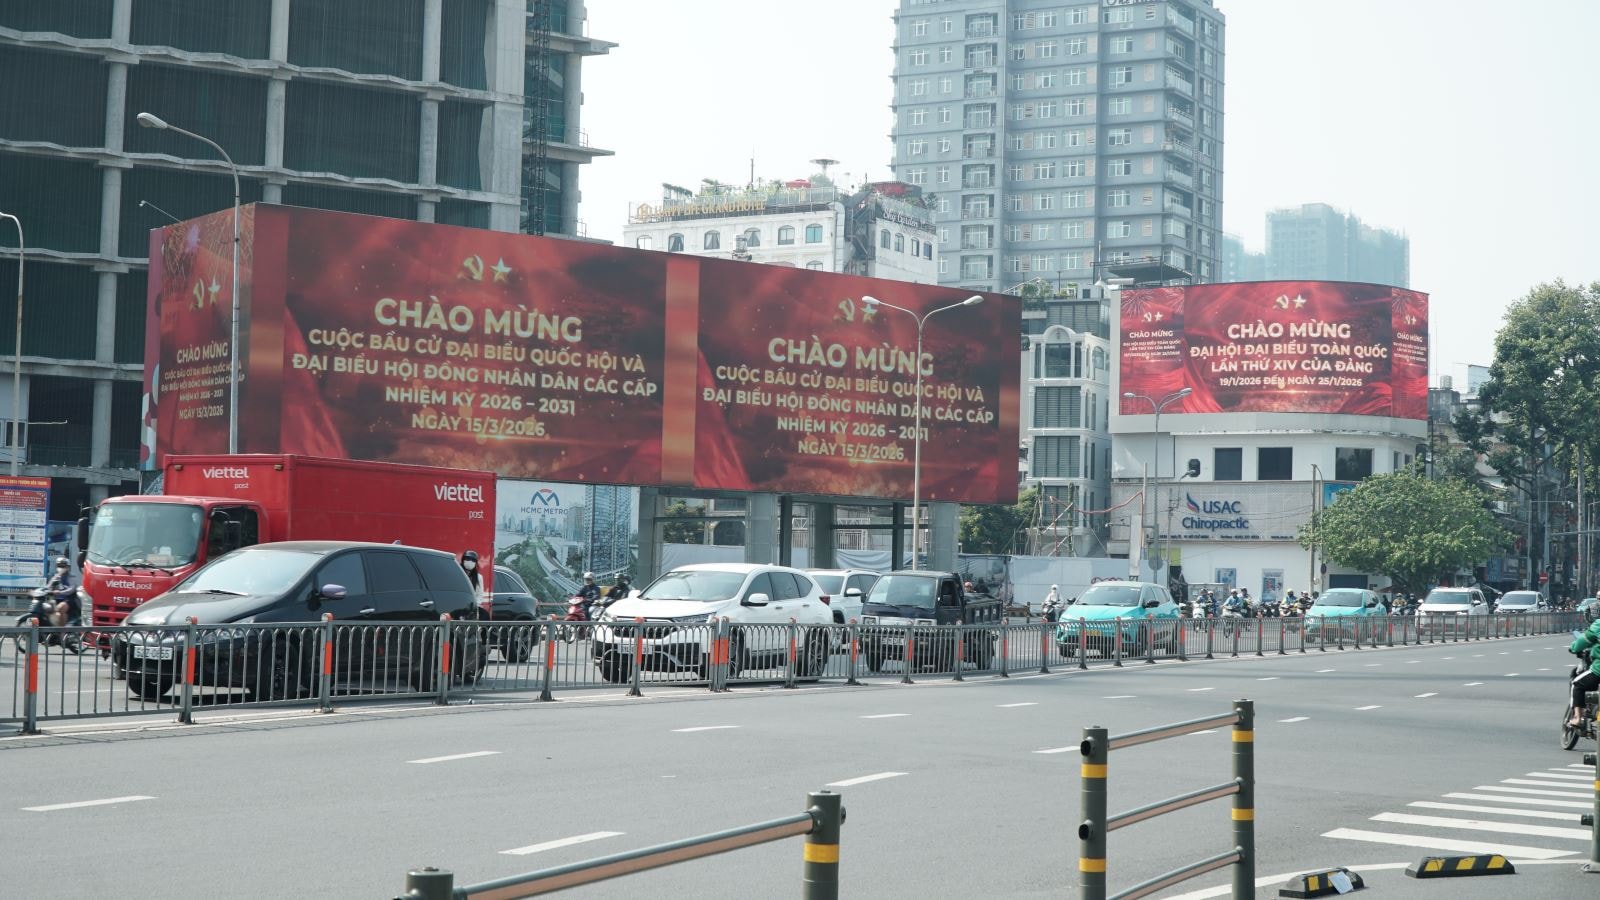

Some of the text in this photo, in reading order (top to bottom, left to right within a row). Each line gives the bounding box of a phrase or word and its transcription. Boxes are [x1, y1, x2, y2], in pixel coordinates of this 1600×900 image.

[684, 204, 700, 215] LIFE
[702, 202, 735, 214] GRAND
[736, 200, 766, 212] HOTEL
[374, 296, 582, 342] CHÀO MỪNG
[1228, 319, 1351, 338] CHÀO MỪNG
[177, 340, 228, 363] CHÀO MỪNG
[309, 328, 645, 373] CUỘC BẦU CỬ ĐẠI BIỂU QUỐC HỘI VÀ
[768, 335, 934, 376] CHÀO MỪNG
[1190, 347, 1213, 360] ĐẠI
[1218, 342, 1240, 358] HỘI
[1244, 345, 1268, 357] ĐẠI
[1273, 340, 1307, 355] BIỂU
[1311, 341, 1350, 356] TOÀN
[1354, 344, 1388, 359] QUỐC
[292, 353, 657, 396] ĐẠI BIỂU HỘI ĐỒNG NHÂN DÂN CÁC CẤP
[1212, 357, 1372, 373] LẦN THỨ XIV CỦA ĐẢNG
[716, 364, 984, 403] CUỘC BẦU CỬ ĐẠI BIỂU QUỐC HỘI VÀ
[1220, 375, 1362, 387] 19/1/2026 ĐẾN NGÀY 25/1/2026
[386, 386, 446, 408] NHIỆM
[452, 388, 476, 407] KỲ
[480, 394, 522, 410] 2026
[538, 398, 575, 416] 2031
[703, 388, 731, 406] ĐẠI
[736, 387, 771, 406] BIỂU
[776, 392, 803, 412] HỘI
[807, 392, 851, 412] ĐỒNG
[855, 399, 897, 416] NHÂN
[935, 405, 962, 422] CÁC
[966, 406, 994, 424] CẤP
[412, 412, 545, 436] NGÀY 15/3/2026
[777, 416, 825, 436] NHIỆM
[830, 419, 848, 434] KỲ
[853, 422, 886, 437] 2026
[798, 439, 904, 460] NGÀY 15/3/2026
[203, 467, 249, 479] viettel
[434, 482, 484, 502] viettel
[469, 510, 484, 520] post
[1203, 501, 1240, 514] USAC
[1182, 517, 1249, 531] Chiropractic
[106, 580, 135, 589] viettel
